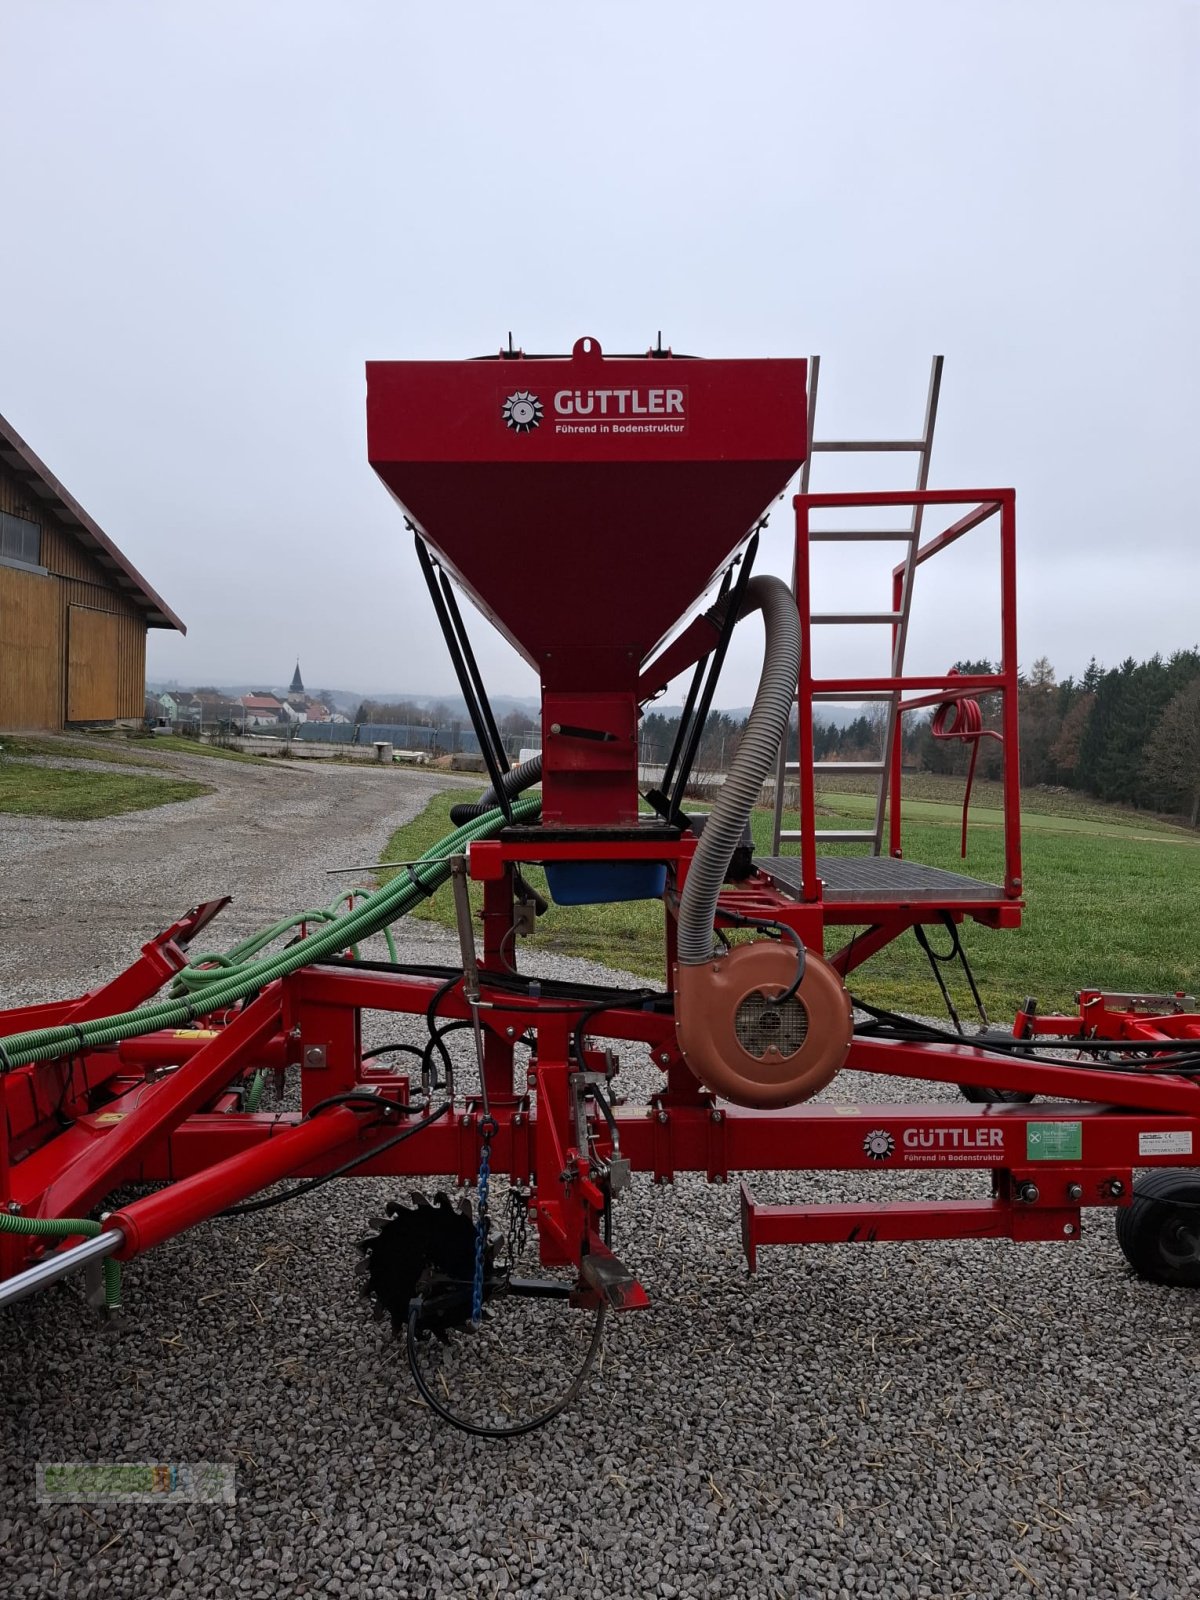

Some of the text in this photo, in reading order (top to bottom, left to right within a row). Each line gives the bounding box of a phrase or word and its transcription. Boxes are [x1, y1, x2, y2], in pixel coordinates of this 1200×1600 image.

[554, 389, 685, 414] GÜTTLER
[555, 424, 685, 433] Führend in Bodenstruktur
[903, 1128, 1004, 1147] GÜTTLER
